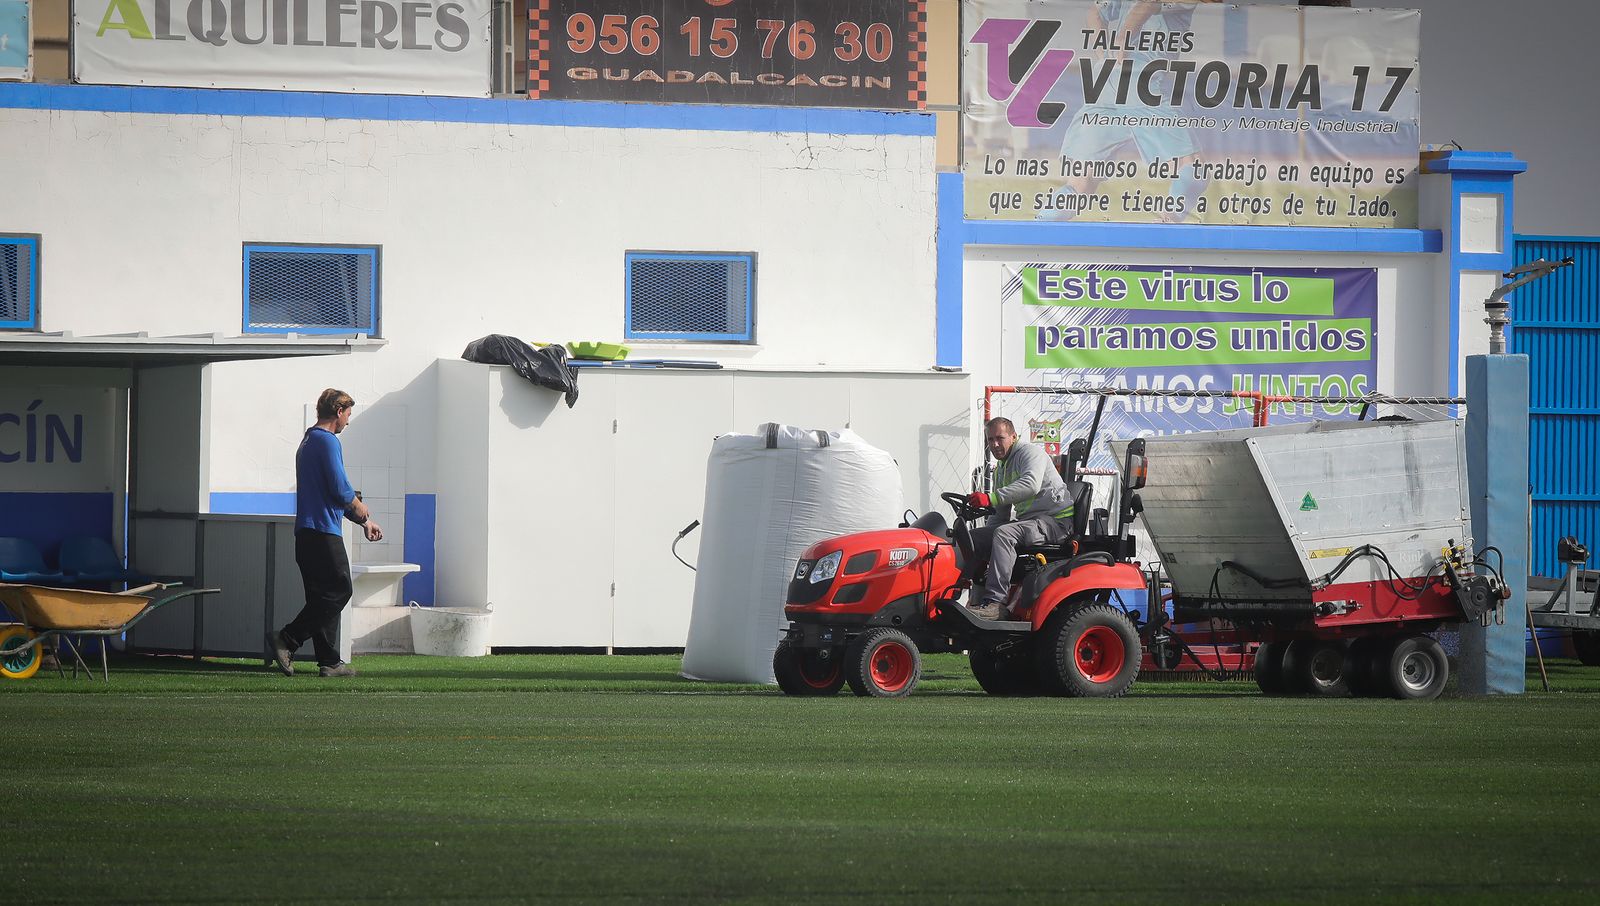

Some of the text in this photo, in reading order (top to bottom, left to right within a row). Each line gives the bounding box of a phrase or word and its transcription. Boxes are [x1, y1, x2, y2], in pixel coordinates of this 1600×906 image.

[96, 0, 471, 52] ALQUILERES
[566, 12, 894, 63] 956 15 76 30
[1081, 29, 1195, 53] TALLERES
[565, 66, 891, 89] GUADALCACIN
[1078, 58, 1323, 110] VICTORIA
[1350, 65, 1415, 113] 17
[1080, 112, 1400, 134] Mantenimiento y Montaje Industrial
[984, 155, 1405, 188] Lo mas hermoso del trabajo en equipo es
[989, 188, 1397, 217] que siempre tienes a otros de tu lado.
[1036, 269, 1291, 303] Este virus lo
[1035, 320, 1367, 354] paramos unidos
[1040, 373, 1369, 416] ESTAMOS JUNTOS
[890, 551, 908, 560] KIOTI
